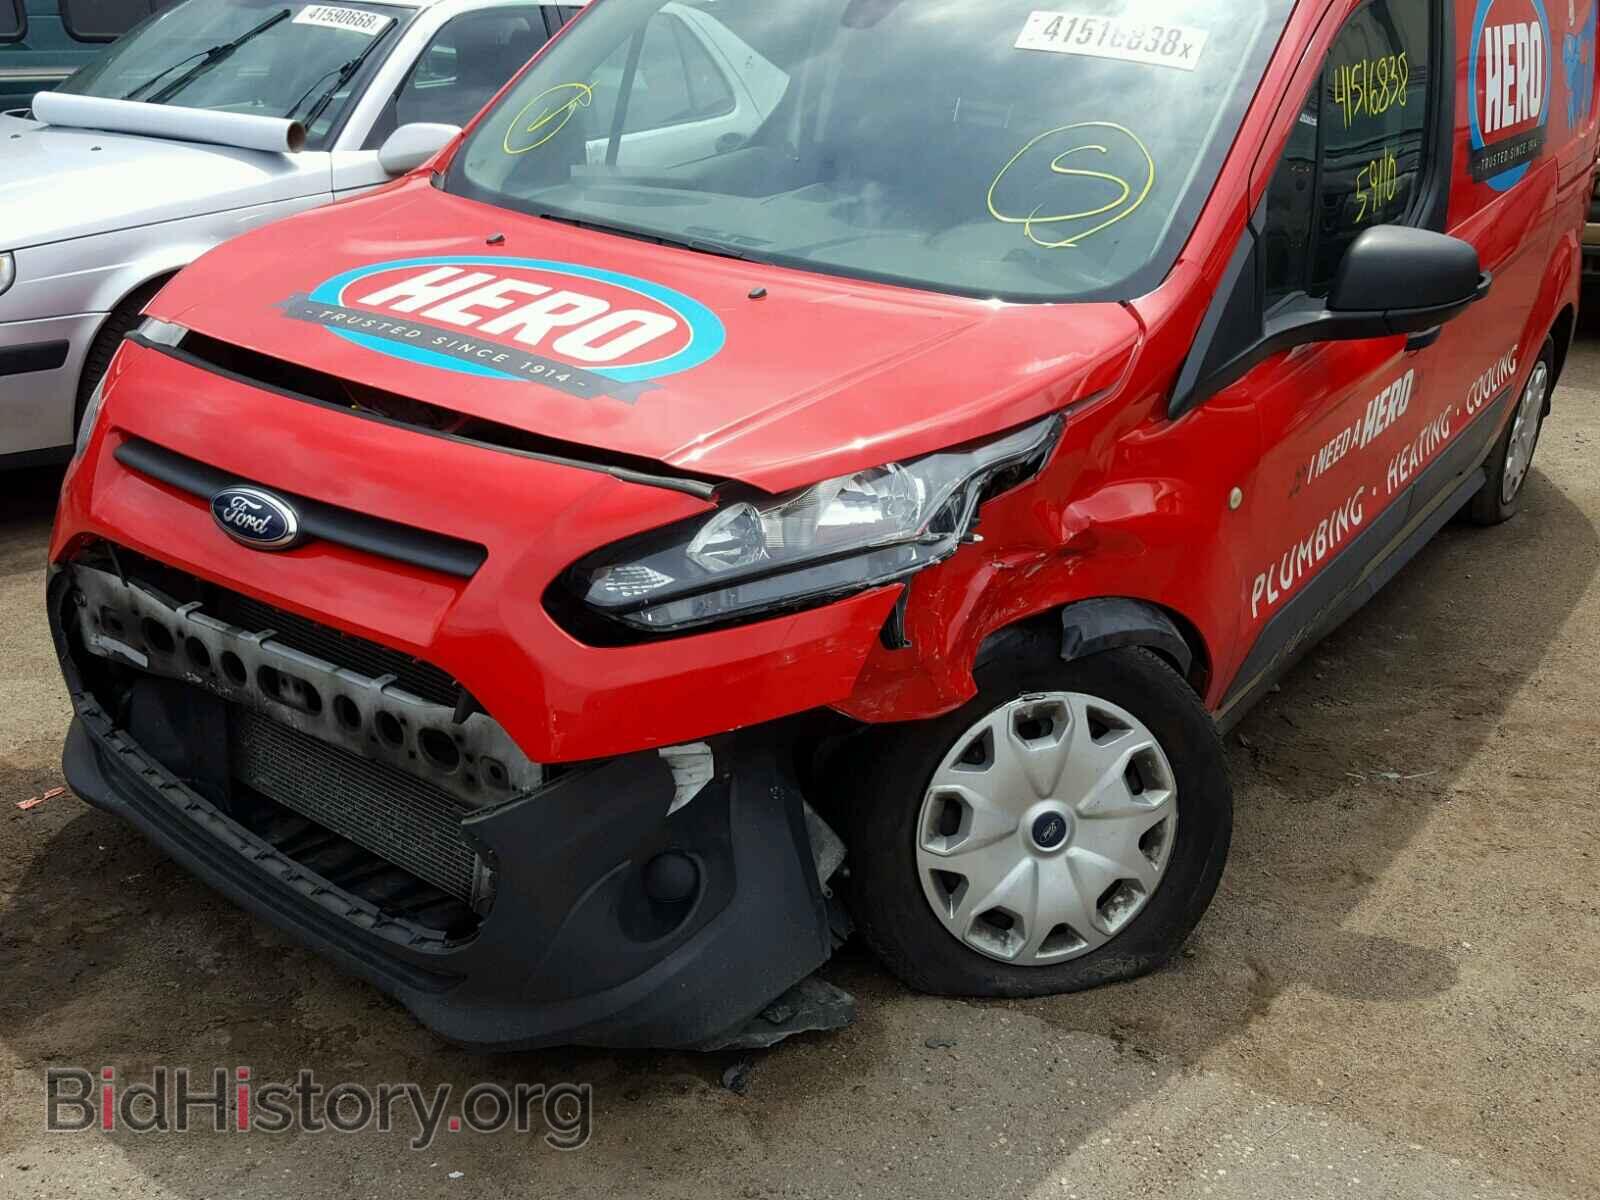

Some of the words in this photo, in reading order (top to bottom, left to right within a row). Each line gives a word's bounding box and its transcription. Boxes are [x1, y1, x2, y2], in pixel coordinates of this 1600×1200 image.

[1334, 48, 1409, 129] 41516838
[1484, 20, 1542, 134] HERO
[1481, 150, 1508, 171] TRUSTED
[319, 309, 422, 339] TRUSTED
[431, 336, 510, 363] SINCE
[519, 360, 571, 383] 1914
[356, 266, 678, 362] HERO
[1307, 454, 1316, 485] I
[1315, 426, 1351, 478] NEED
[1350, 418, 1361, 449] A
[1360, 369, 1414, 450] HERO
[223, 495, 273, 534] Ford
[1251, 486, 1365, 618] PLUMBING
[1387, 404, 1452, 495] HEATING
[1466, 344, 1518, 415] COOLING
